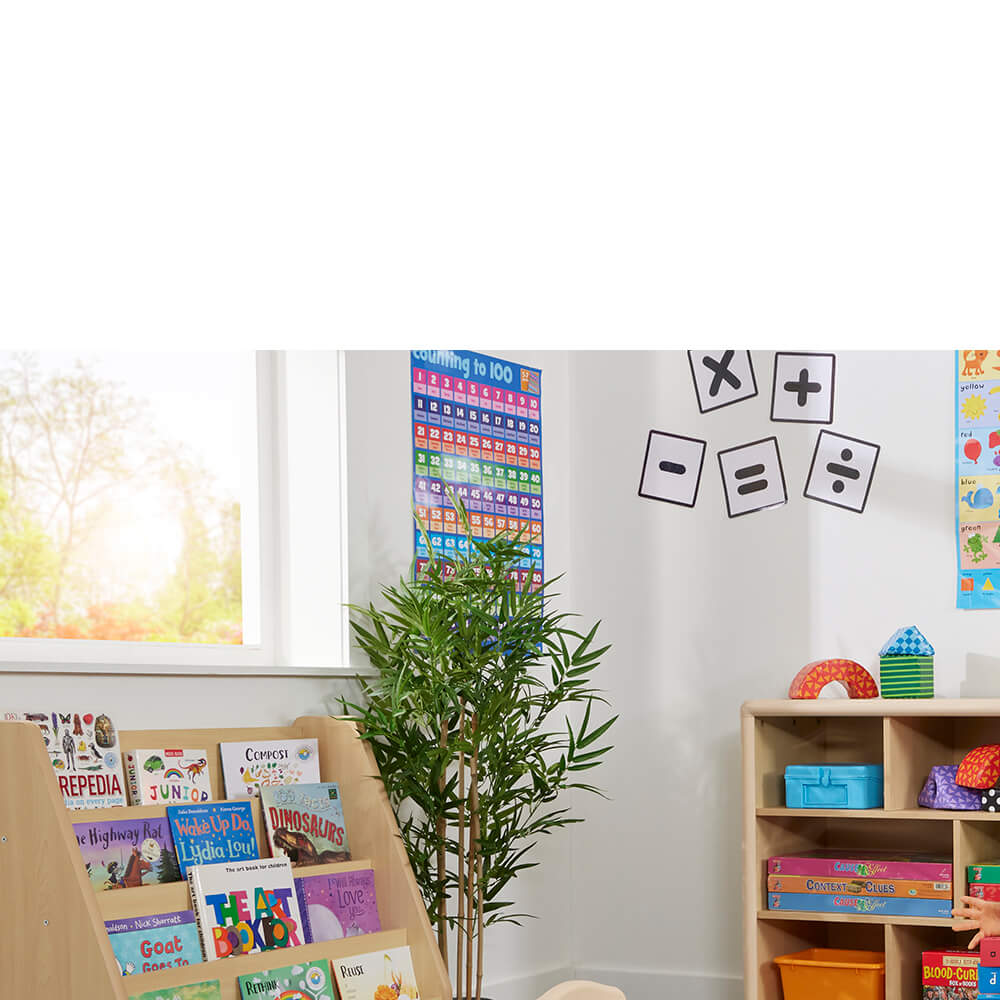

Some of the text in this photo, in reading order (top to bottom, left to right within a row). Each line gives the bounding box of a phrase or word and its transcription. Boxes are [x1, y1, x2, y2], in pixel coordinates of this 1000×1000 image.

[474, 358, 486, 376] to
[489, 361, 513, 384] 100
[960, 383, 985, 392] yellow
[417, 426, 478, 446] 21 22 23 24 25
[960, 525, 981, 533] green
[58, 774, 122, 797] REPEDIA
[150, 785, 208, 802] JUNIOR
[89, 824, 139, 849] Highway
[143, 822, 163, 840] Rat
[174, 817, 210, 837] Wake
[209, 815, 229, 836] Up
[269, 807, 344, 846] DINOSAURS
[180, 840, 225, 865] Lydia
[227, 837, 255, 858] Lou!
[205, 887, 292, 927] THE ART
[134, 919, 151, 929] Nick
[140, 935, 183, 958] Goat
[212, 917, 301, 957] BOOK FOR
[923, 965, 978, 981] BLOOD-CUR
